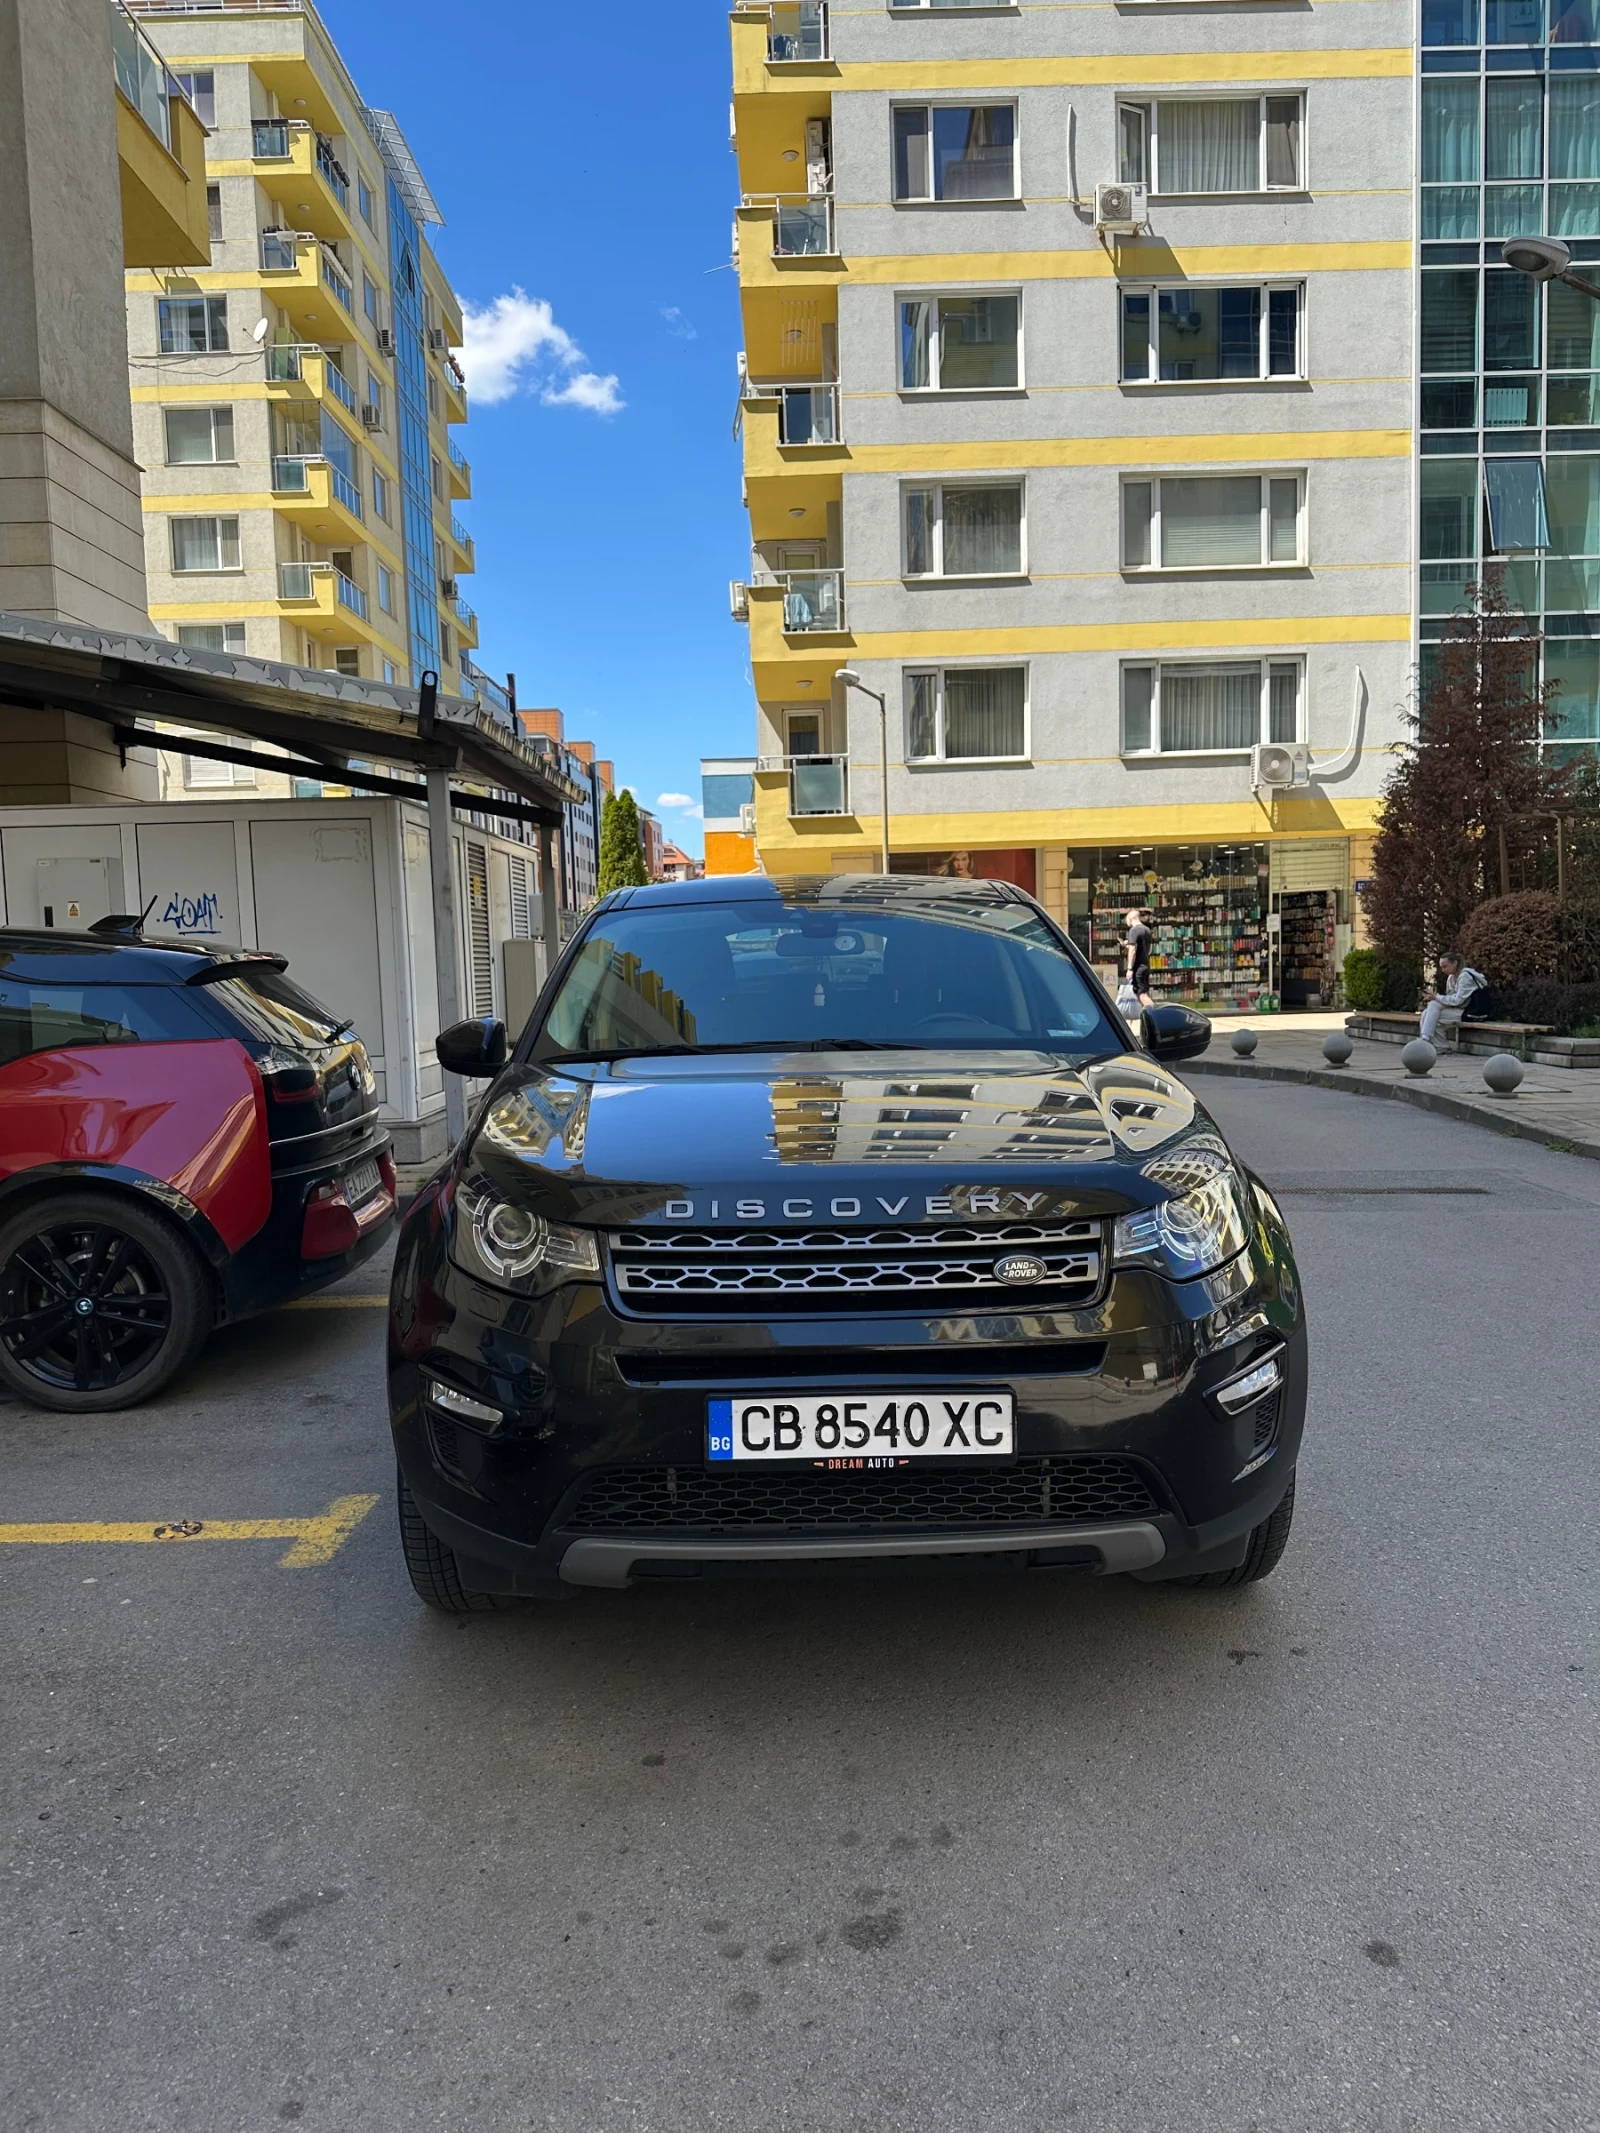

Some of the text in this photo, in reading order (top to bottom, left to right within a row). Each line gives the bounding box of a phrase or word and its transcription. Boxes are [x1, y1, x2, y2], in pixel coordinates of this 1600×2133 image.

[666, 1192, 1043, 1219] DISCOVERY
[1005, 1261, 1029, 1271] LAND
[1008, 1268, 1038, 1278] ROVER
[741, 1401, 1004, 1451] CB 8540 XC
[711, 1436, 731, 1451] BG
[828, 1457, 895, 1469] DREAM AUTO
